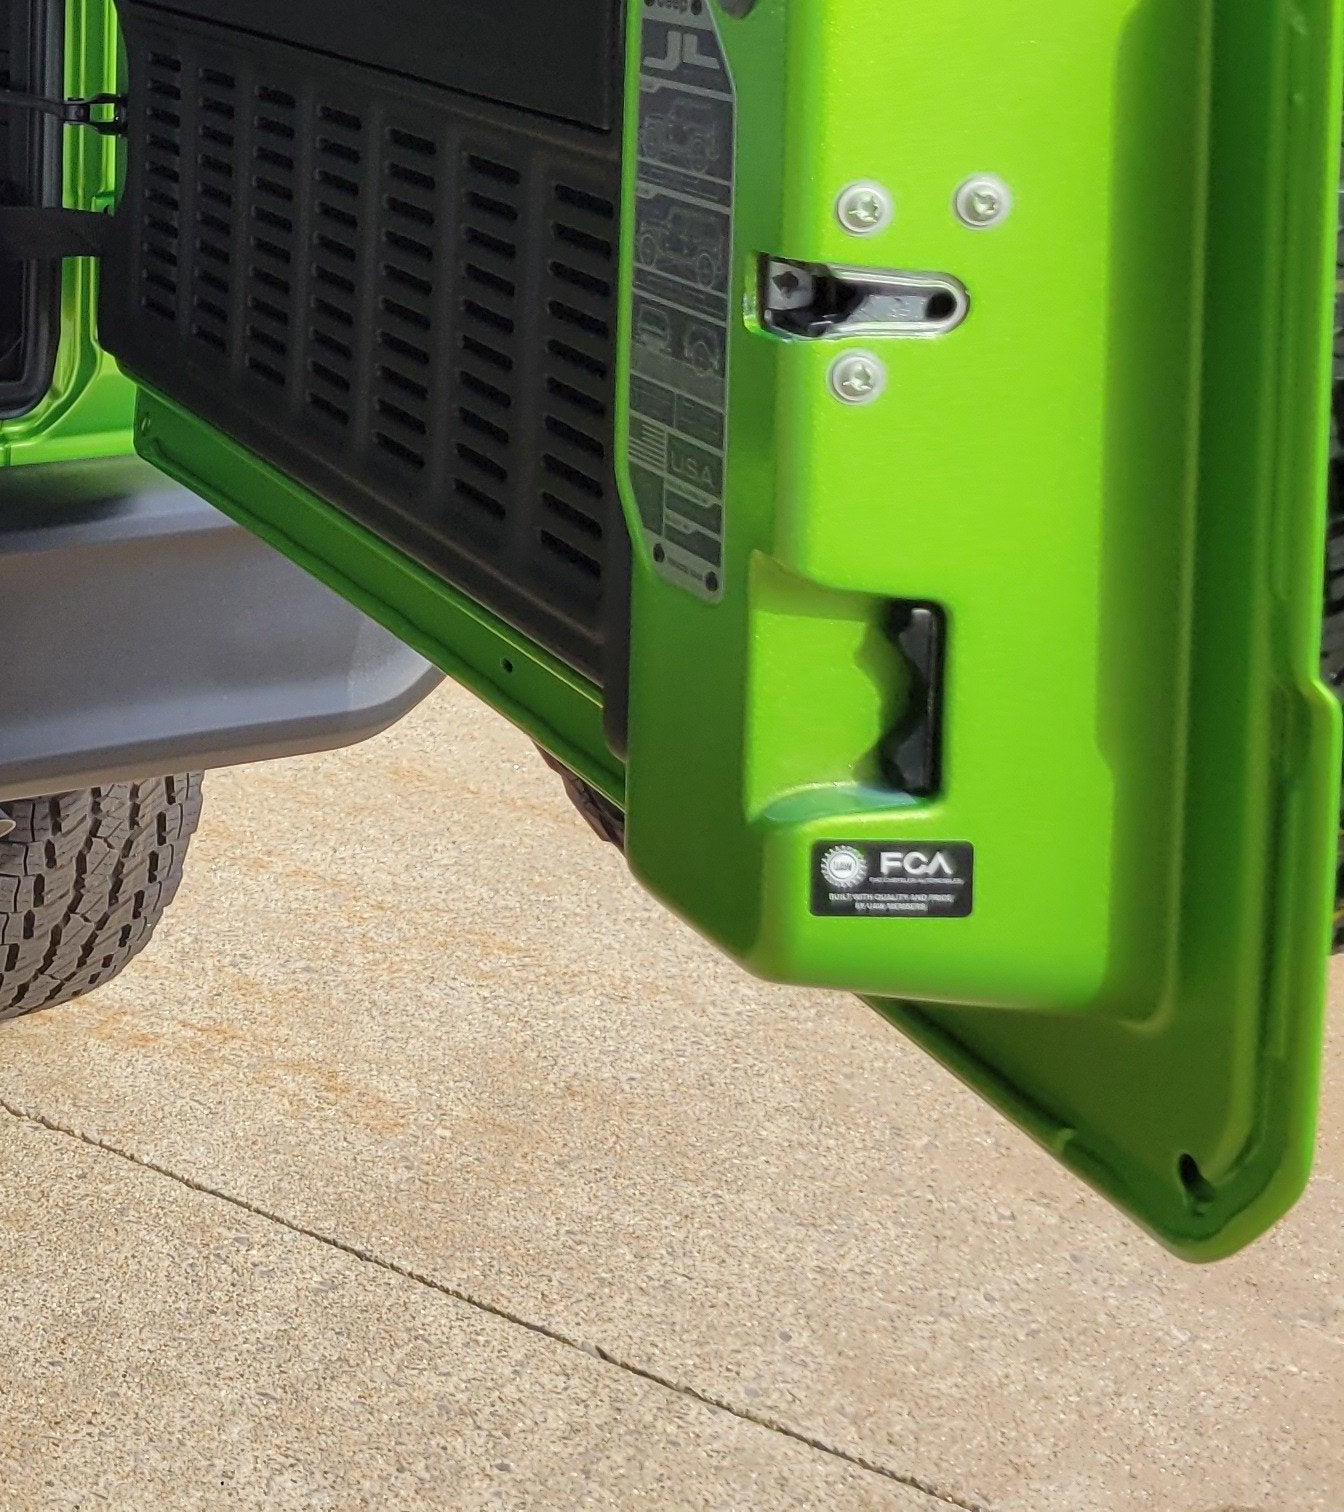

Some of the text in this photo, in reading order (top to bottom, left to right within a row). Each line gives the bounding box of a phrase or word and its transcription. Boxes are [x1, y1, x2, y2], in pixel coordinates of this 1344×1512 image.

[642, 30, 720, 71] JL
[670, 450, 715, 489] USA
[879, 851, 953, 876] FCA
